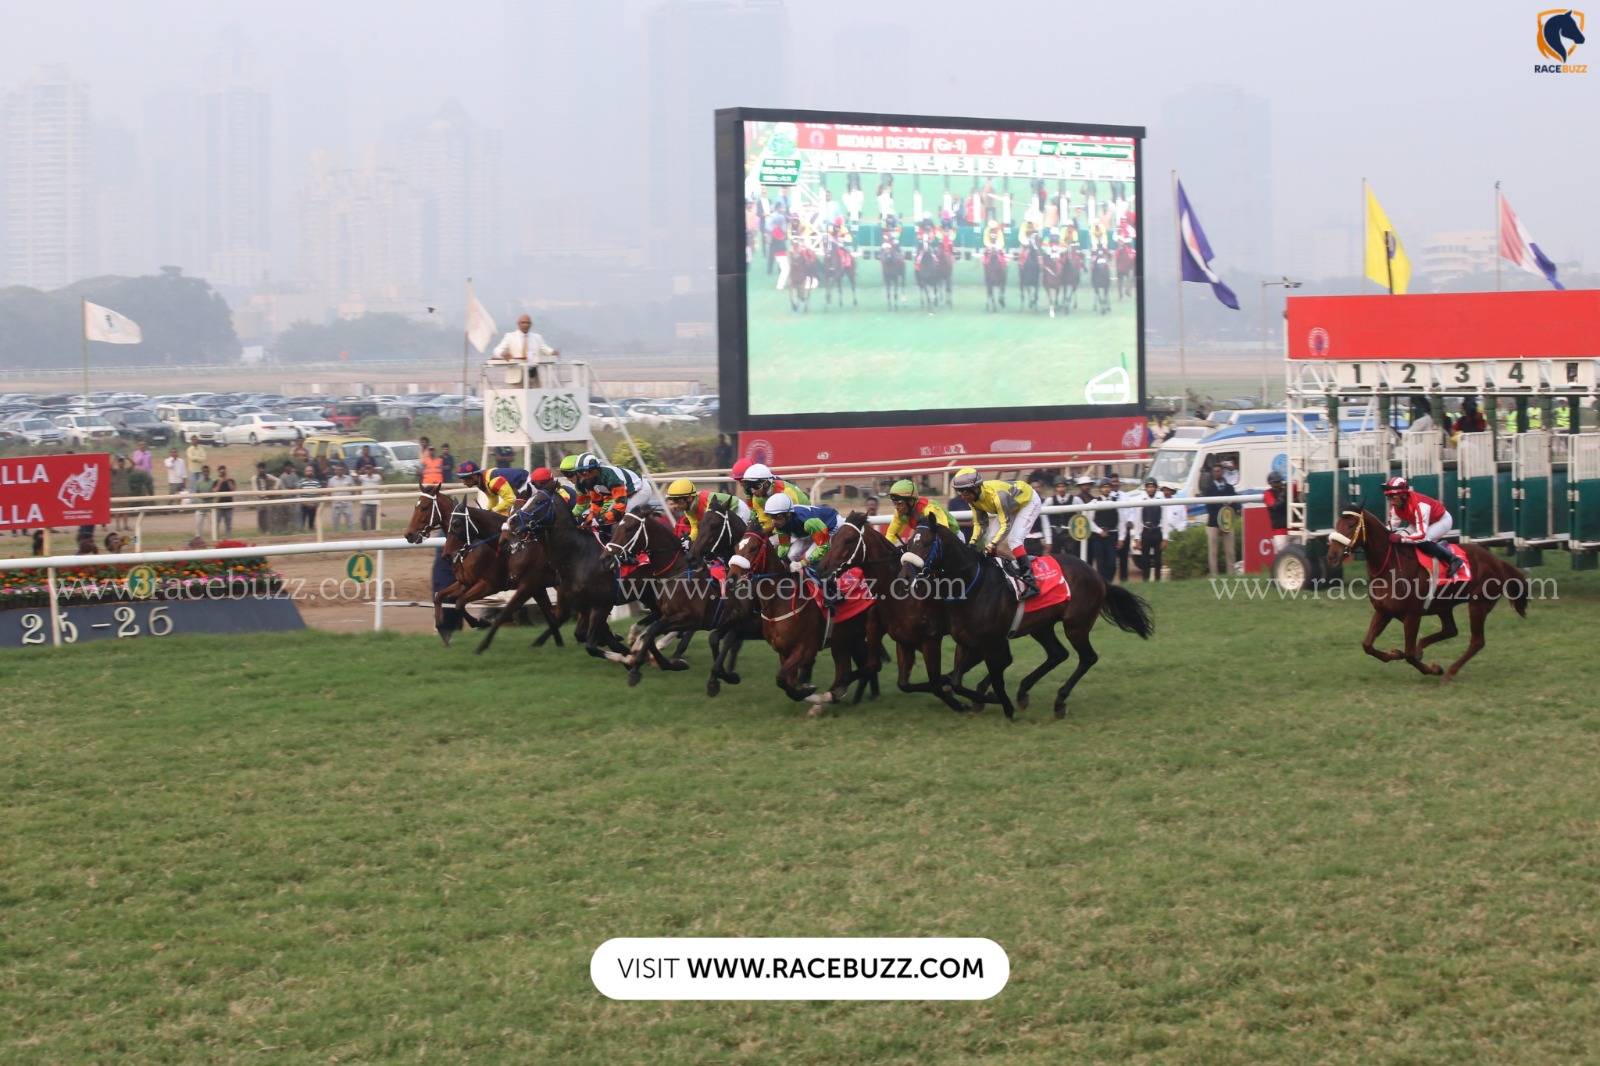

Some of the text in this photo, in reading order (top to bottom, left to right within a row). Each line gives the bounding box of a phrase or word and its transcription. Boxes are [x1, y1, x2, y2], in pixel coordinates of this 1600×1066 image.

[836, 133, 884, 149] INDIAN
[885, 135, 931, 151] DERBY
[1352, 362, 1525, 384] 1 2 3 4
[0, 463, 50, 485] LLA
[1074, 515, 1087, 539] 8
[1222, 508, 1233, 531] 9
[352, 556, 368, 581] 4
[135, 568, 149, 594] 3
